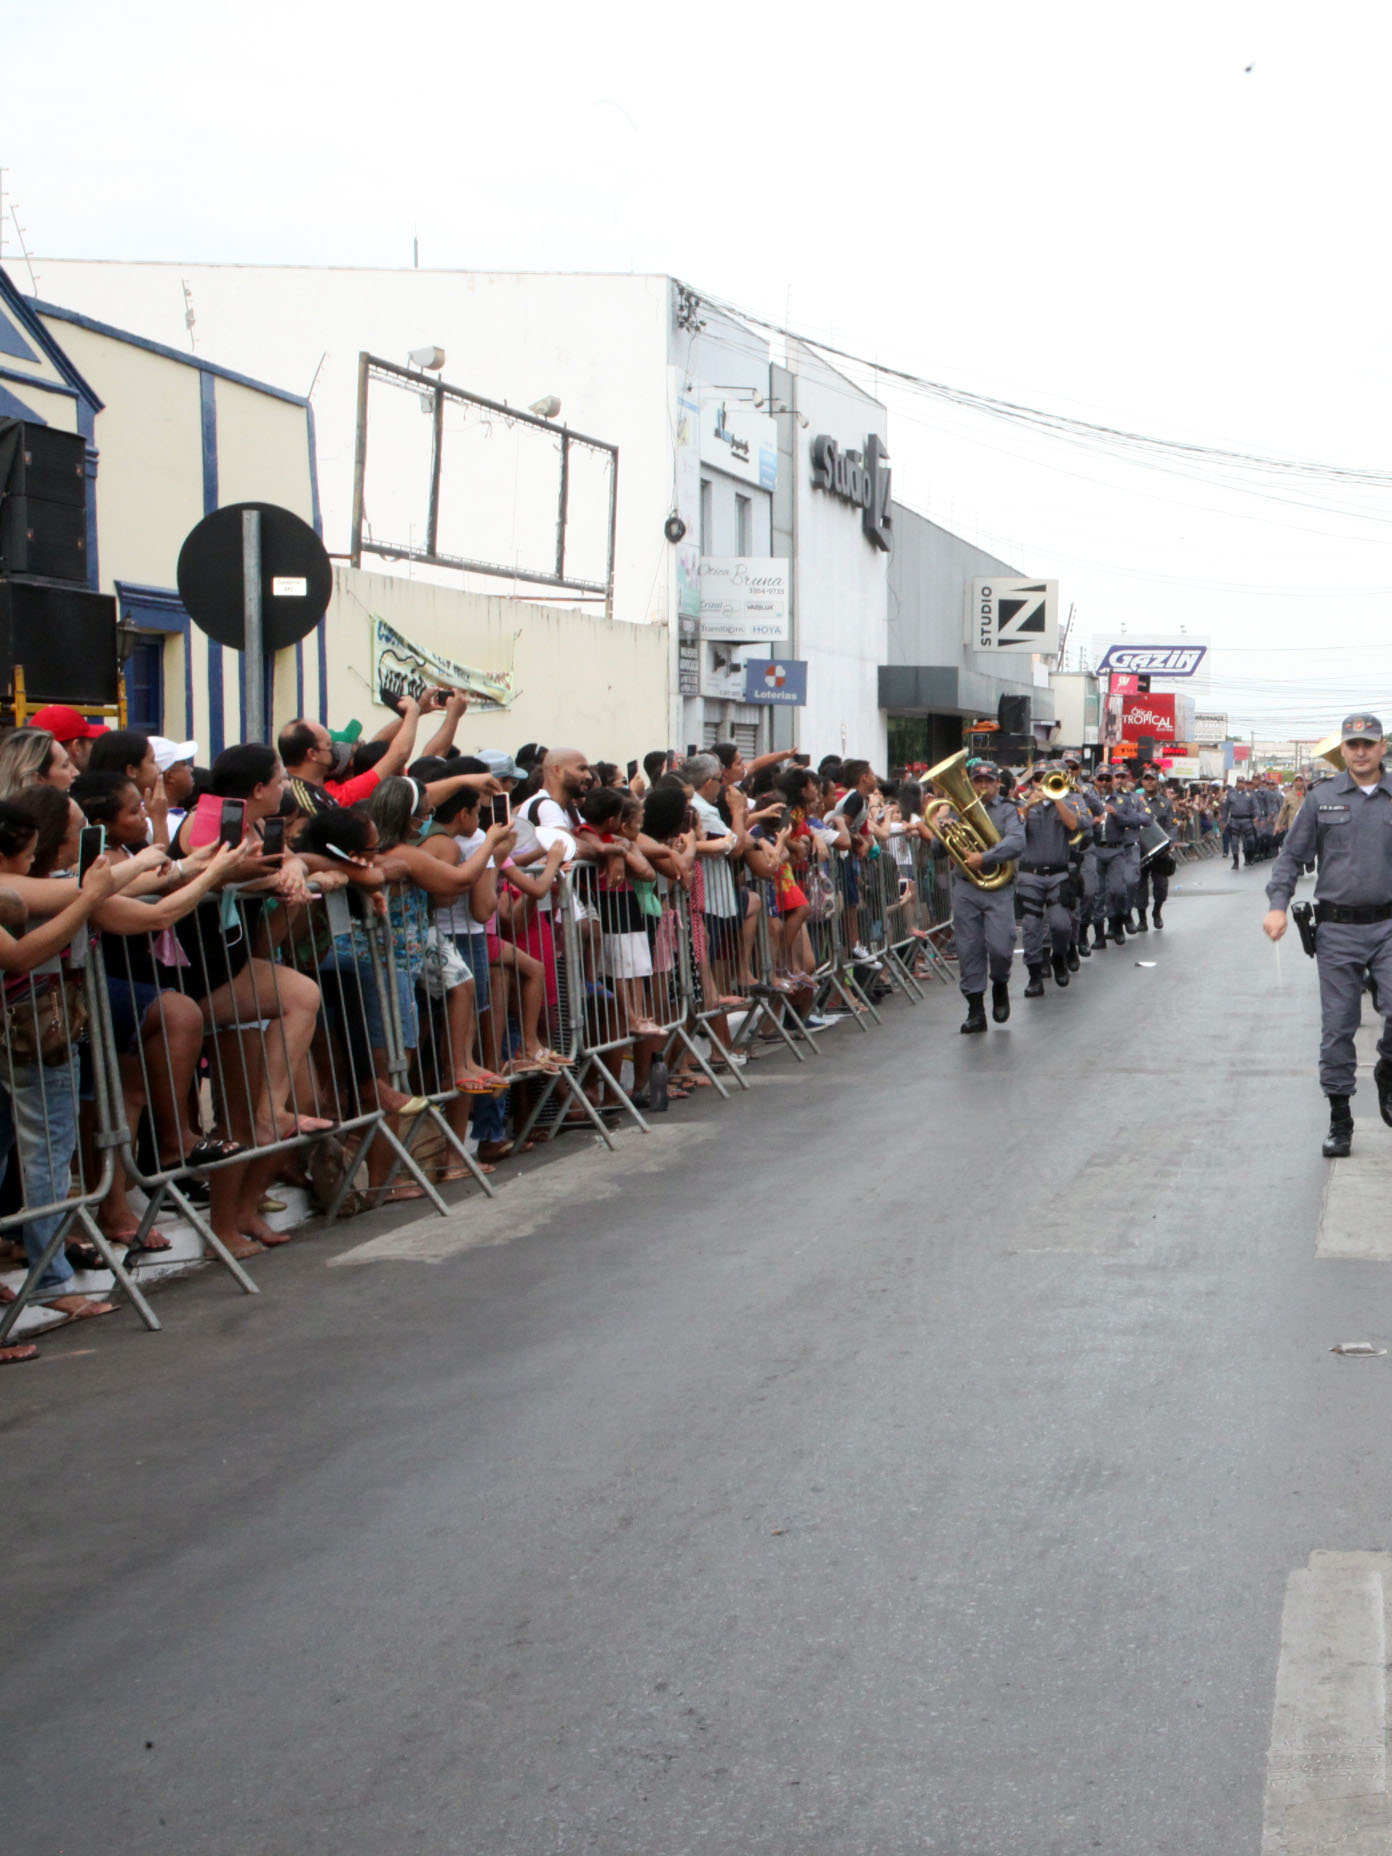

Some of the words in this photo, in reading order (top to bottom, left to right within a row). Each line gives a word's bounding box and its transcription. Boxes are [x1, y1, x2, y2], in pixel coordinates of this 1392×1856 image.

[813, 434, 873, 509] Studio
[730, 563, 785, 587] Bruna
[749, 587, 785, 595] 3364-9733
[980, 585, 993, 648] STUDIO
[752, 625, 783, 634] HOYA
[1108, 649, 1202, 670] GAZIN
[754, 689, 798, 700] Loterias
[1122, 714, 1174, 729] TROPICAL
